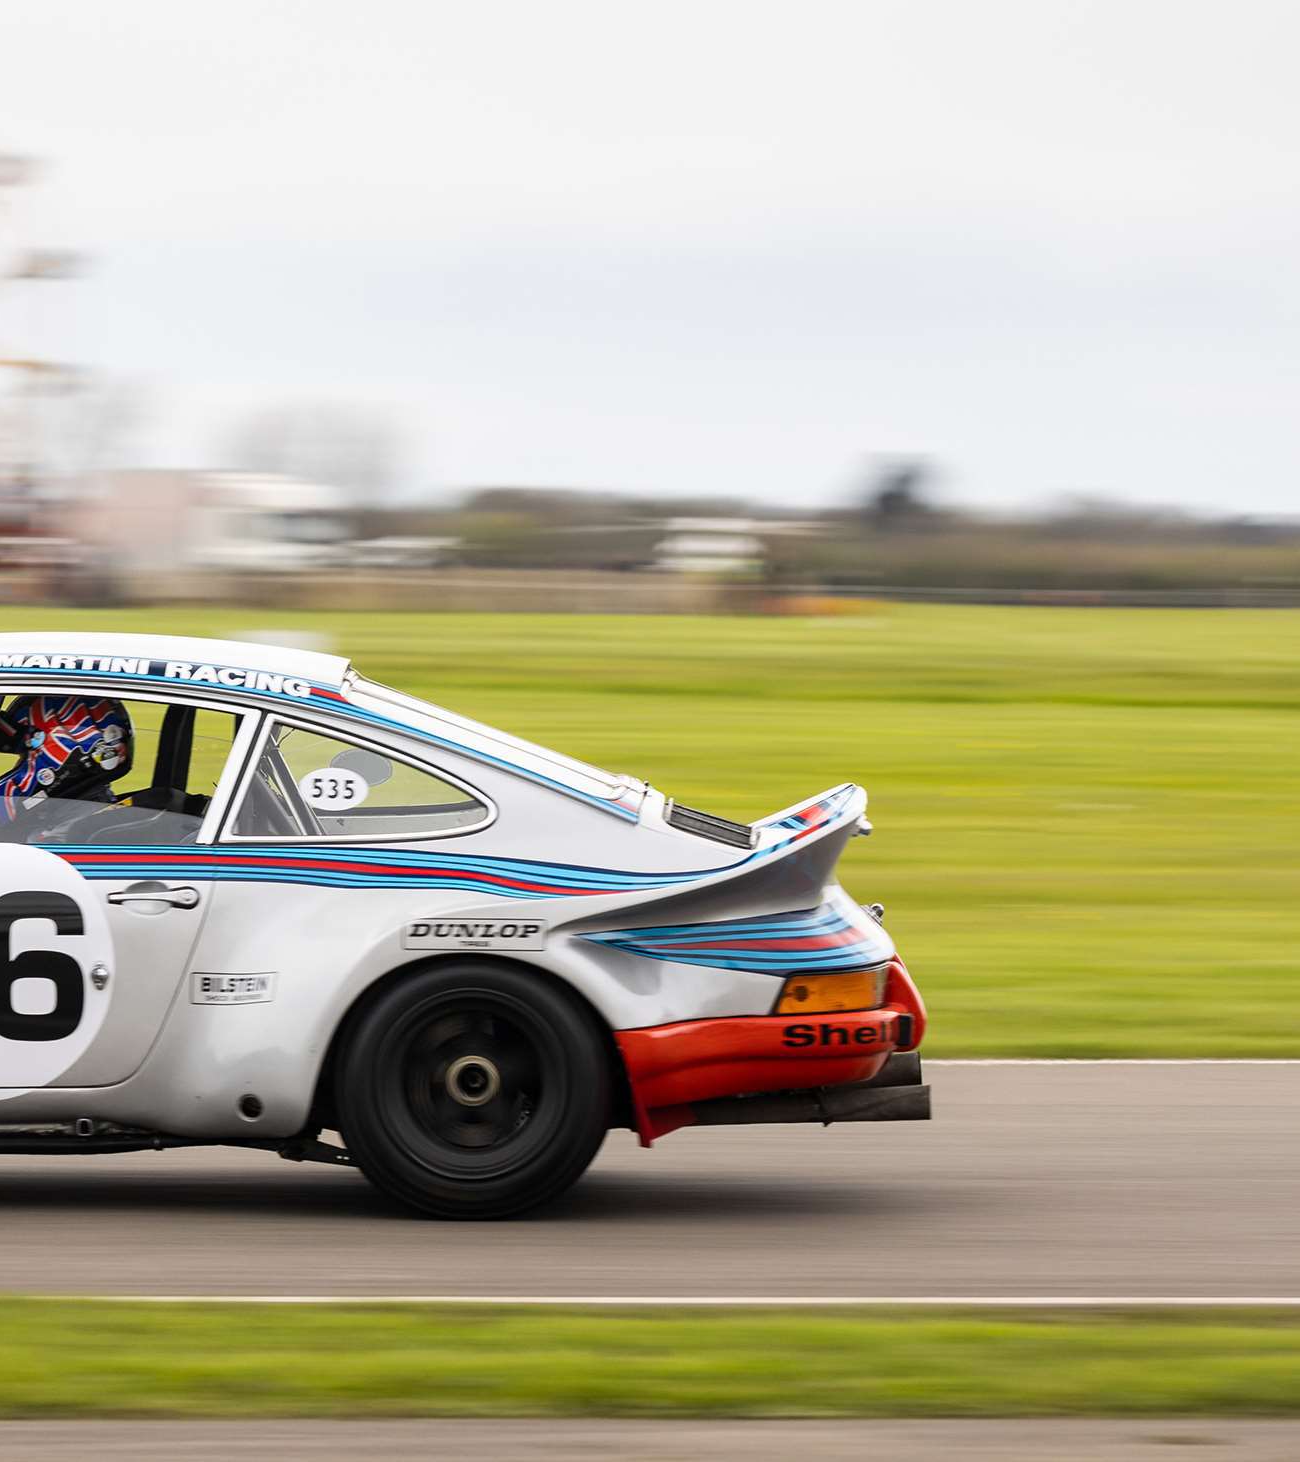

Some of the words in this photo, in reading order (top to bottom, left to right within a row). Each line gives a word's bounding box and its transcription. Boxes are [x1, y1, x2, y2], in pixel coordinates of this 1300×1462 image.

[164, 661, 311, 698] RACING
[312, 778, 354, 800] 535
[408, 923, 540, 938] DUNLOP
[201, 977, 267, 993] BILSTEIN
[782, 1021, 892, 1047] Shel
